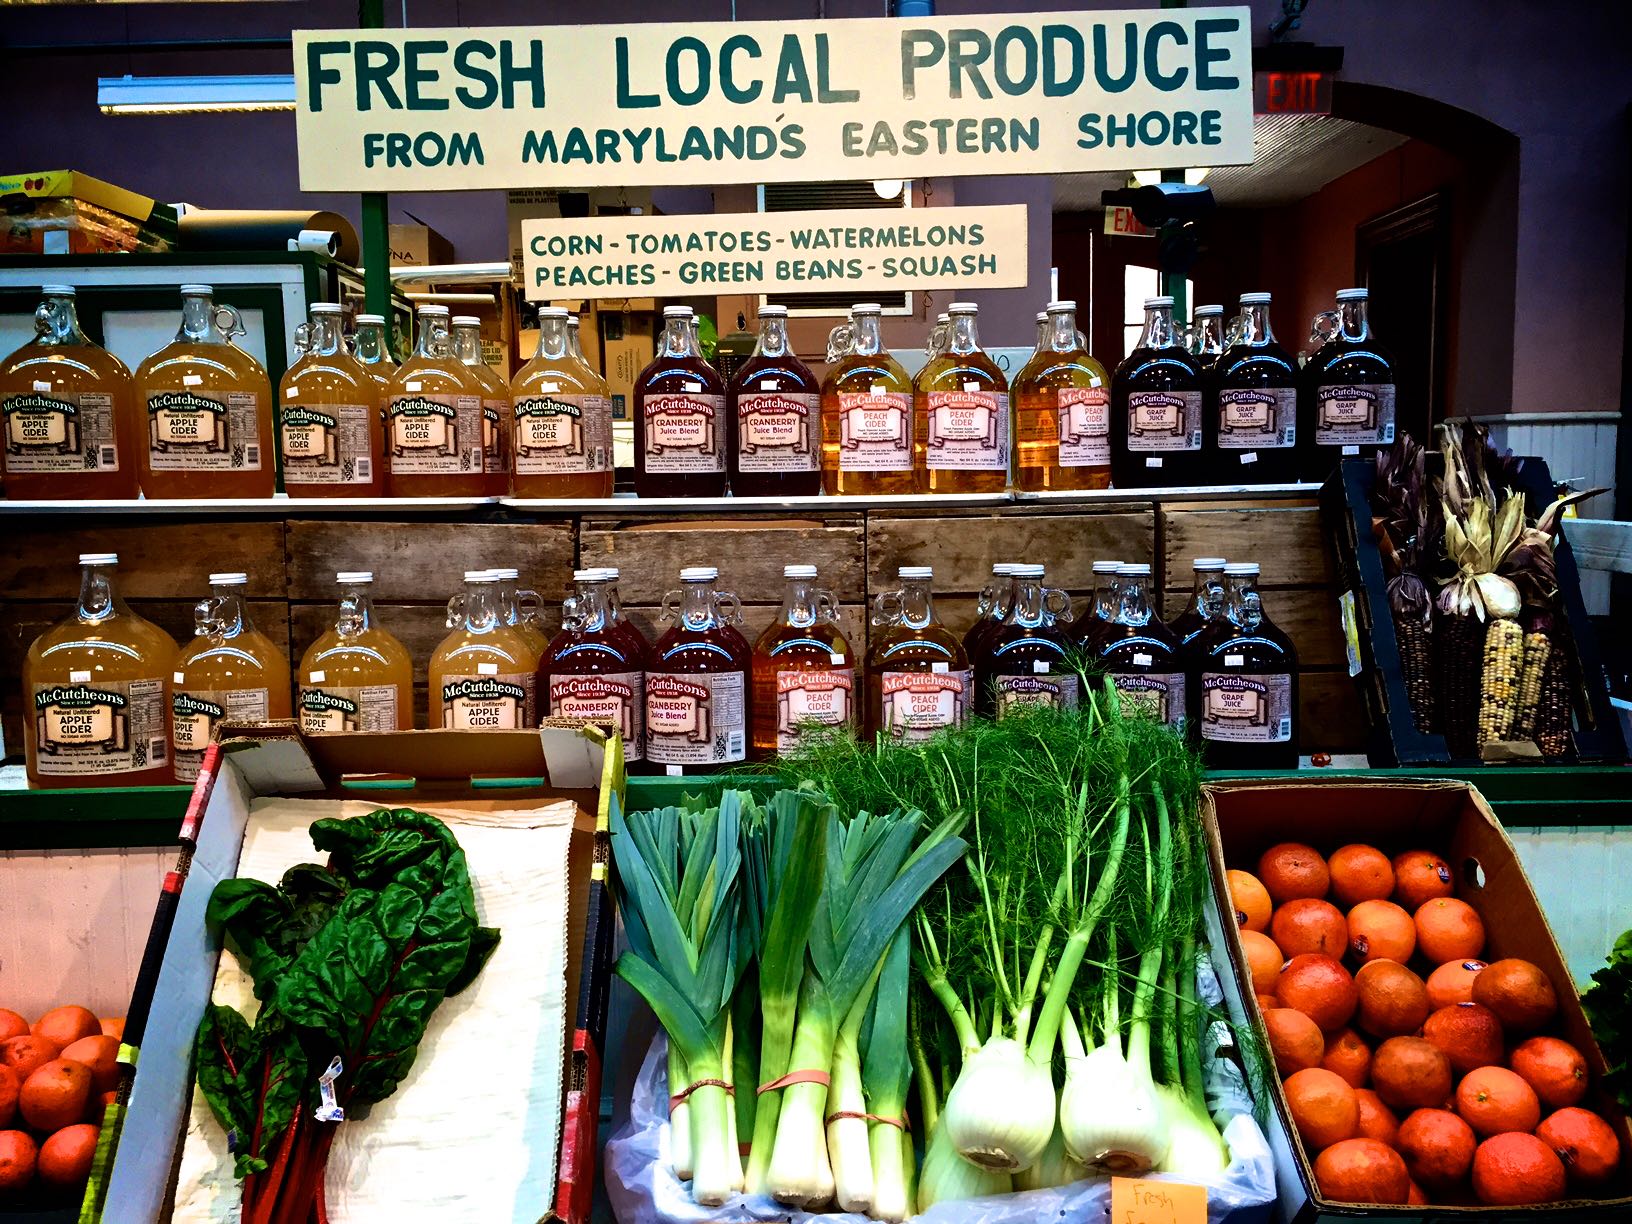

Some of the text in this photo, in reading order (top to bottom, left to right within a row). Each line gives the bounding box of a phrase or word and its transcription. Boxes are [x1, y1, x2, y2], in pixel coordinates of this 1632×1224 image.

[306, 18, 1240, 112] FRESH LOCAL PRODUCE
[1267, 72, 1321, 113] EXIT
[363, 109, 1222, 169] FROM MARYLAND'S EASTERN SHORE
[530, 234, 603, 257] CORN
[626, 231, 771, 254] TOMATOES
[790, 223, 985, 250] WATERMELONS
[535, 263, 656, 288] PEACHES
[679, 260, 764, 285] GREEN
[775, 258, 863, 281] BEANS
[882, 253, 997, 278] SQUASH
[3, 396, 75, 414] McCutcheon's
[149, 394, 224, 412] McCutcheon's
[515, 399, 580, 417] McCutcheon's
[740, 398, 807, 415] McCutcheon's
[284, 409, 334, 426] Cutcheon's
[864, 412, 888, 420] PEACH
[950, 411, 975, 419] PEACH
[656, 419, 703, 427] CRANBERRY
[749, 418, 797, 426] CRANBERRY
[865, 420, 886, 428] CIDER
[23, 429, 48, 437] CIDER
[406, 431, 429, 439] CIDER
[532, 431, 557, 439] CIDER
[884, 674, 961, 691] McCutcheon's
[1115, 677, 1167, 691] cCutcheon's
[444, 680, 524, 699] McCutcheon's
[552, 679, 631, 698] McCutcheon's
[37, 687, 124, 706] McCutcheon's
[302, 691, 354, 711] Cutcheon's
[806, 694, 832, 702] PEACH
[911, 696, 939, 704] PEACH
[564, 702, 619, 712] CRANBERRY
[649, 700, 693, 710] CRANBERRY
[807, 702, 831, 710] CIDER
[912, 705, 937, 713] CIDER
[468, 708, 500, 716] APPLE
[60, 716, 93, 724] APPLE
[305, 719, 326, 727] APPLE
[469, 717, 499, 725] CIDER
[61, 725, 92, 734] CIDER
[1133, 1184, 1174, 1210] Fresh
